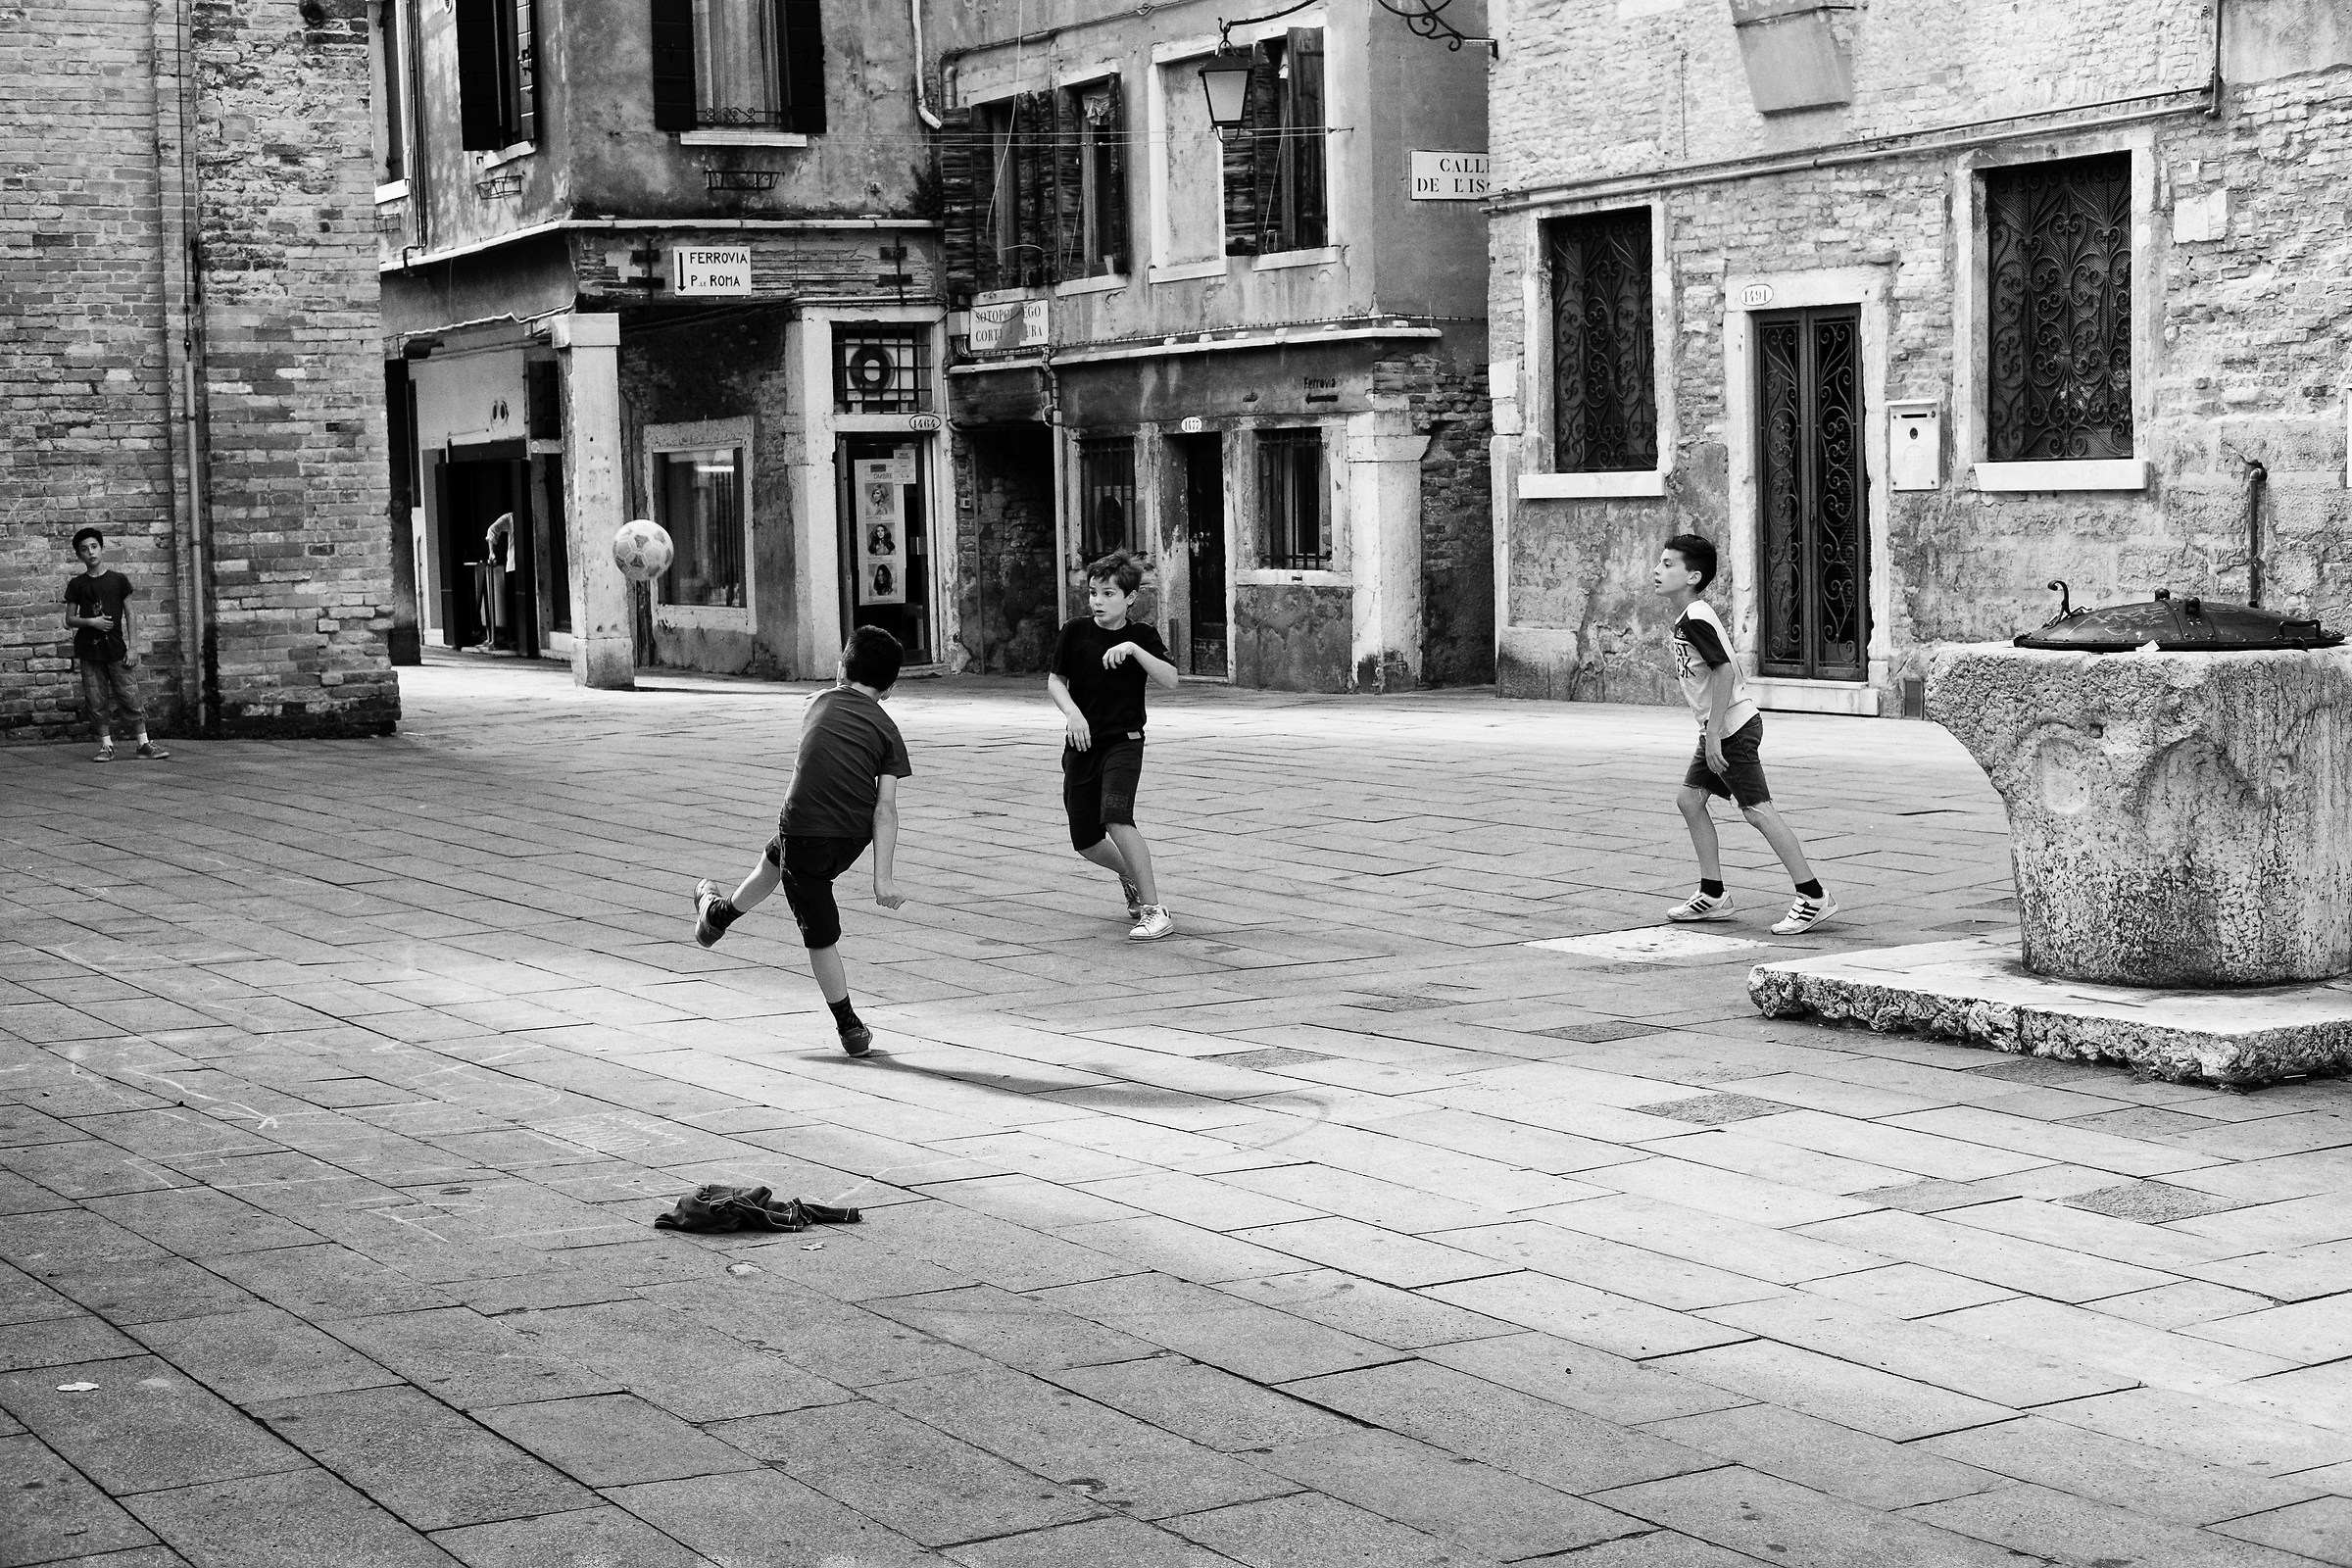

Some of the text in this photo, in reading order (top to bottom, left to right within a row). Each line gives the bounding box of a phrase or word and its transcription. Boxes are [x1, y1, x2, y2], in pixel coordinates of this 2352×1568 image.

[1417, 177, 1440, 192] DE
[690, 252, 748, 265] FERROVIA
[710, 275, 741, 287] ROMA
[1744, 289, 1767, 303] 1491
[1303, 377, 1336, 390] Ferrovia
[913, 418, 936, 429] 1464
